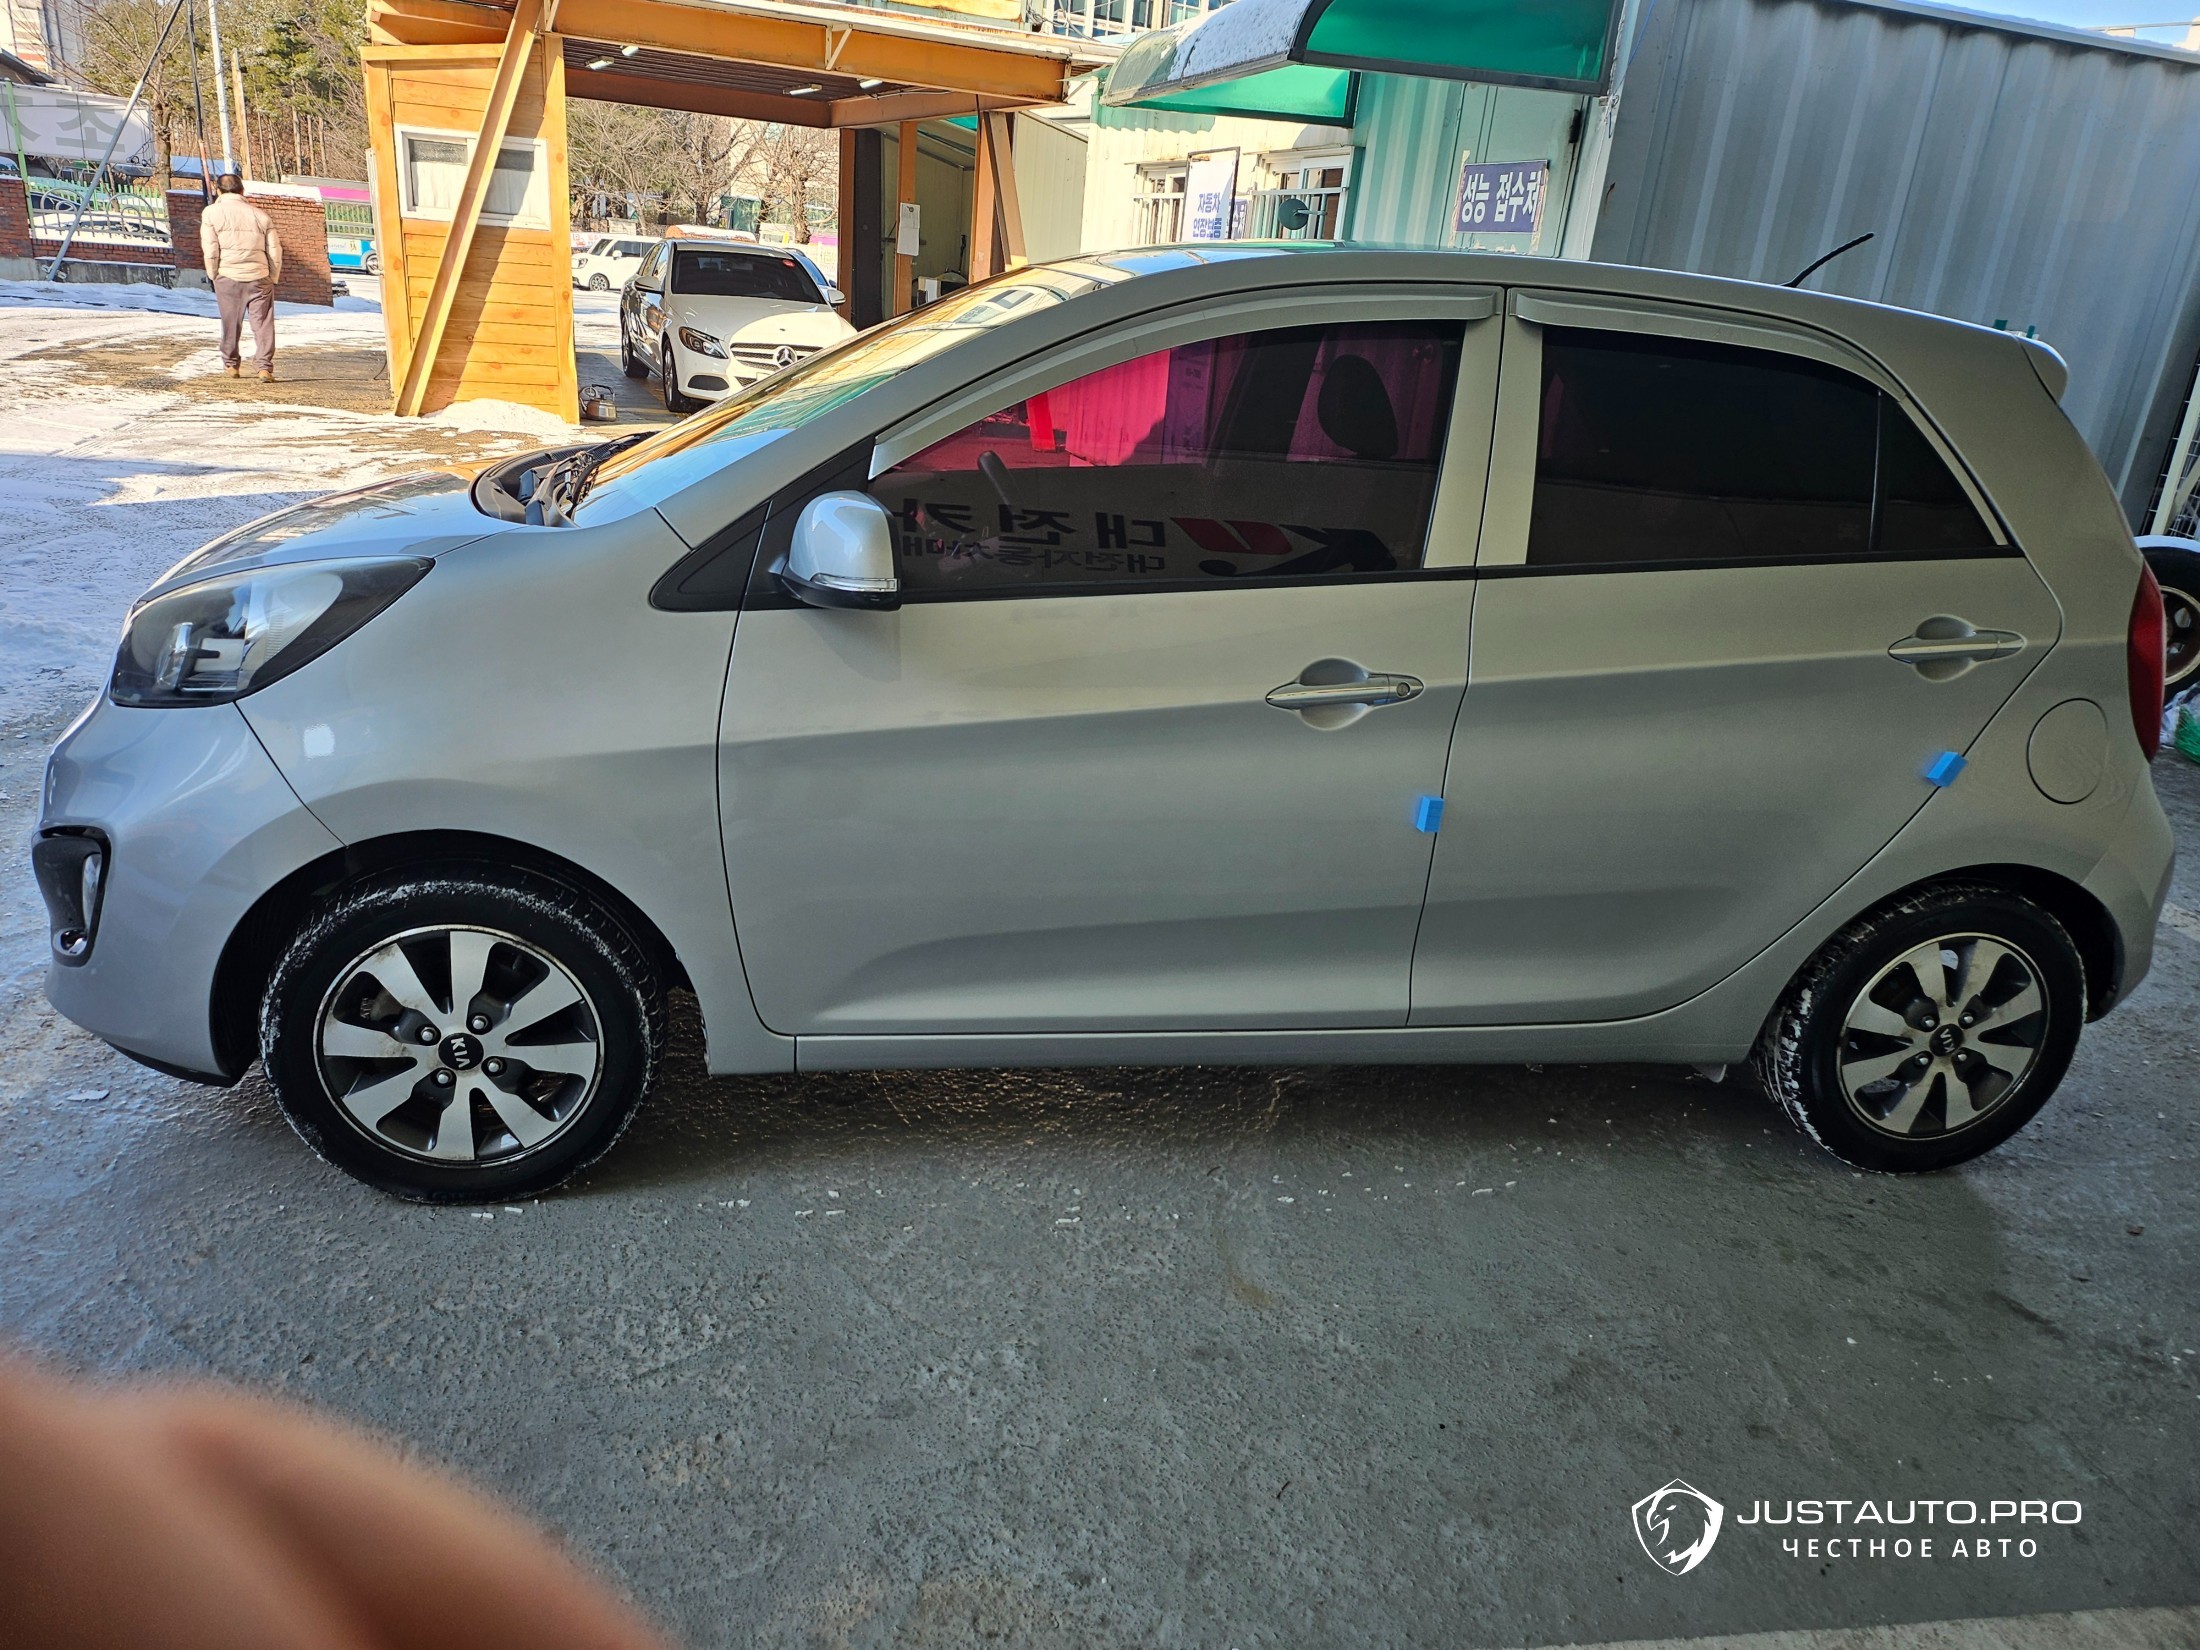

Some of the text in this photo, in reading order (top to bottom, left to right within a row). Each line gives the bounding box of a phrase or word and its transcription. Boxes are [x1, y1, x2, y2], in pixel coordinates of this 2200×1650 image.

[1197, 192, 1221, 214] 자동차
[1461, 170, 1542, 223] 성능 접수처
[450, 1037, 471, 1068] KIA
